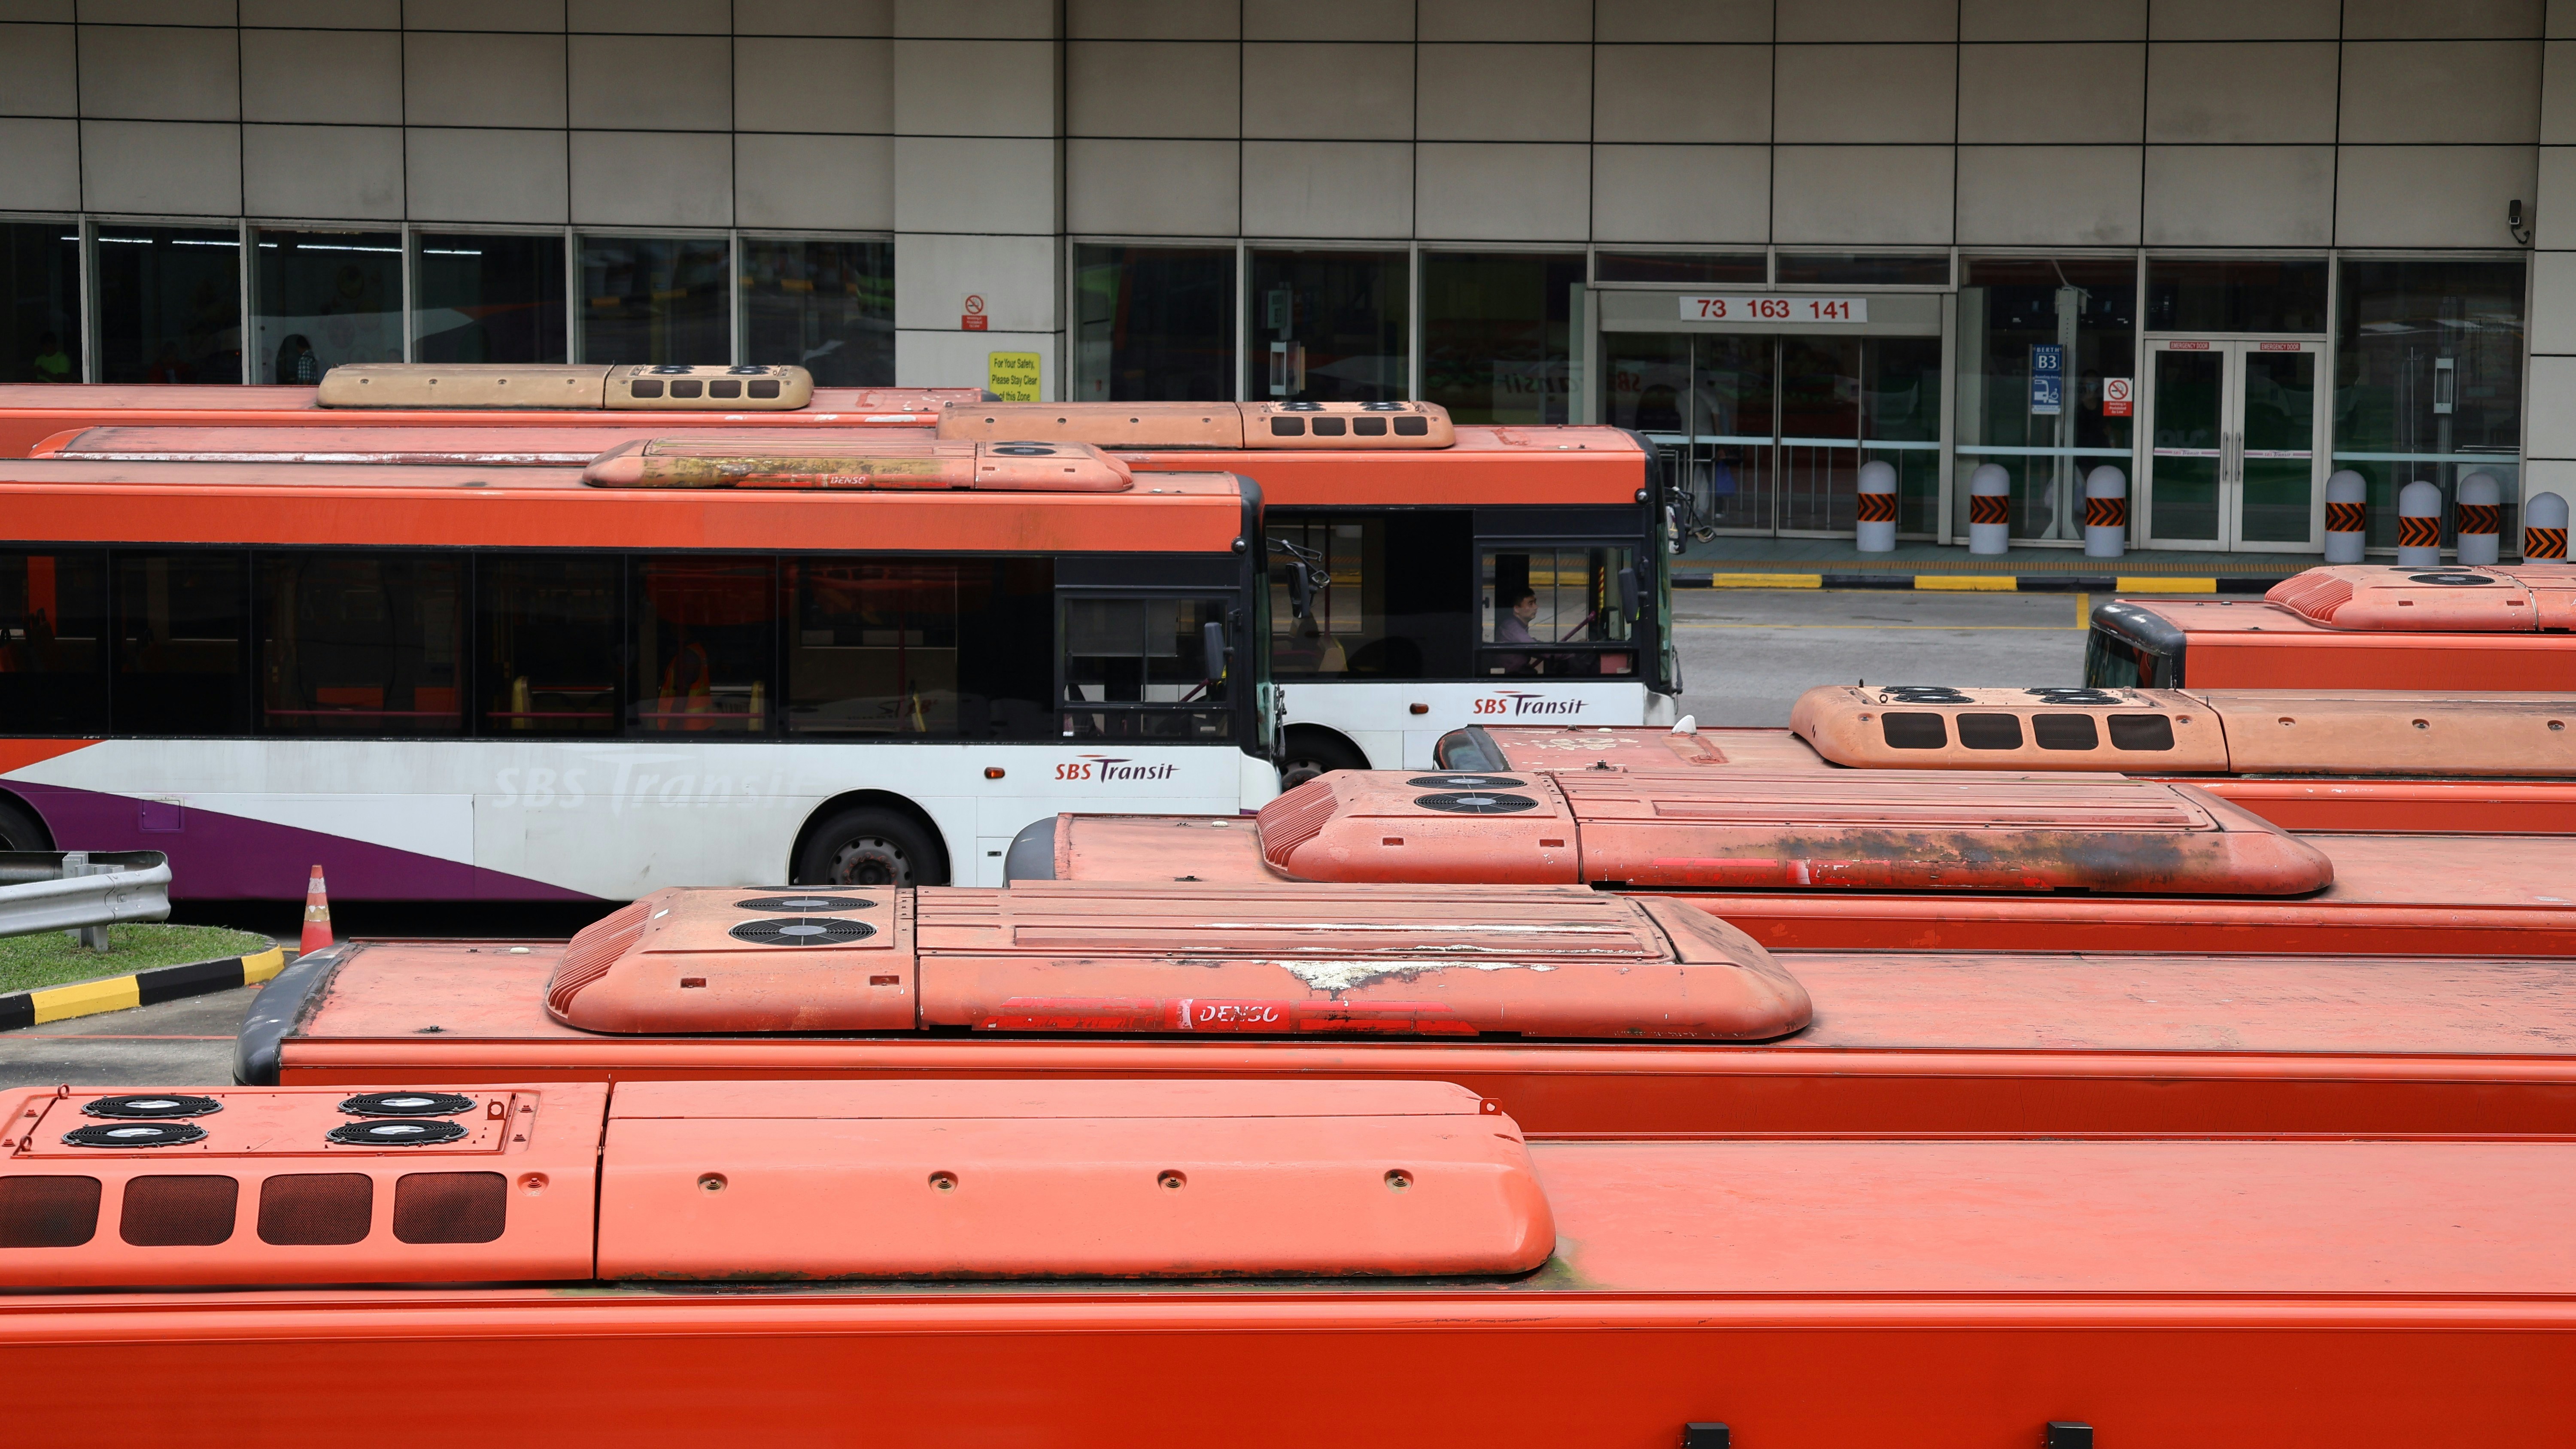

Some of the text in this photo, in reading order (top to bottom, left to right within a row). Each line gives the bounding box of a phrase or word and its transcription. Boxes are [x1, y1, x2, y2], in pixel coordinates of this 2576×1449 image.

[1698, 300, 1849, 319] 73 163 141
[994, 358, 1035, 370] For Your Safety,
[2039, 355, 2057, 369] B3
[992, 374, 1037, 387] Please Stay Clear
[999, 391, 1030, 401] of this Zone
[1473, 694, 1589, 717] SBS Transit
[1054, 759, 1181, 784] SBS Transit
[492, 753, 823, 818] SBS Transit
[1200, 1006, 1279, 1022] DENSO
